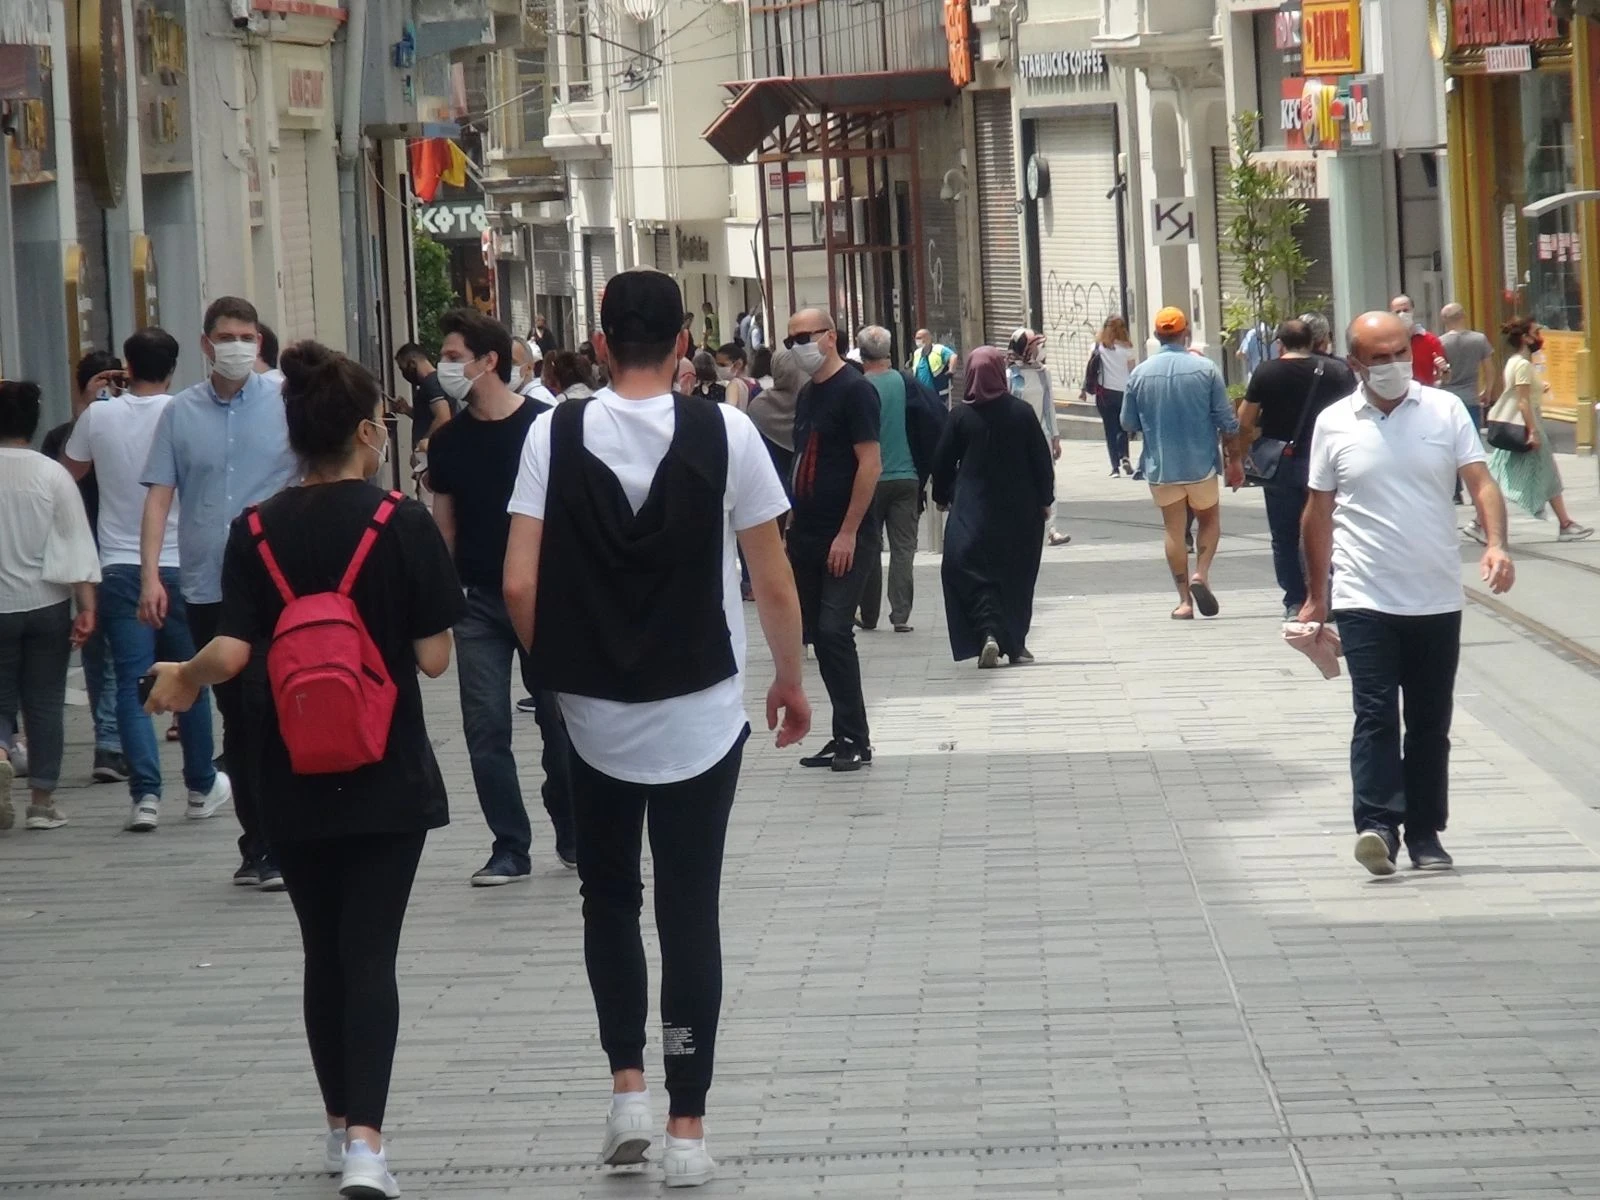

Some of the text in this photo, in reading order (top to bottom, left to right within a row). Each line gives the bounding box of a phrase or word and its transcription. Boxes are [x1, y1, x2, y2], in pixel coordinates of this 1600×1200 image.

[1019, 49, 1104, 78] STARBUCKS COFFEE
[1280, 99, 1302, 130] KFC
